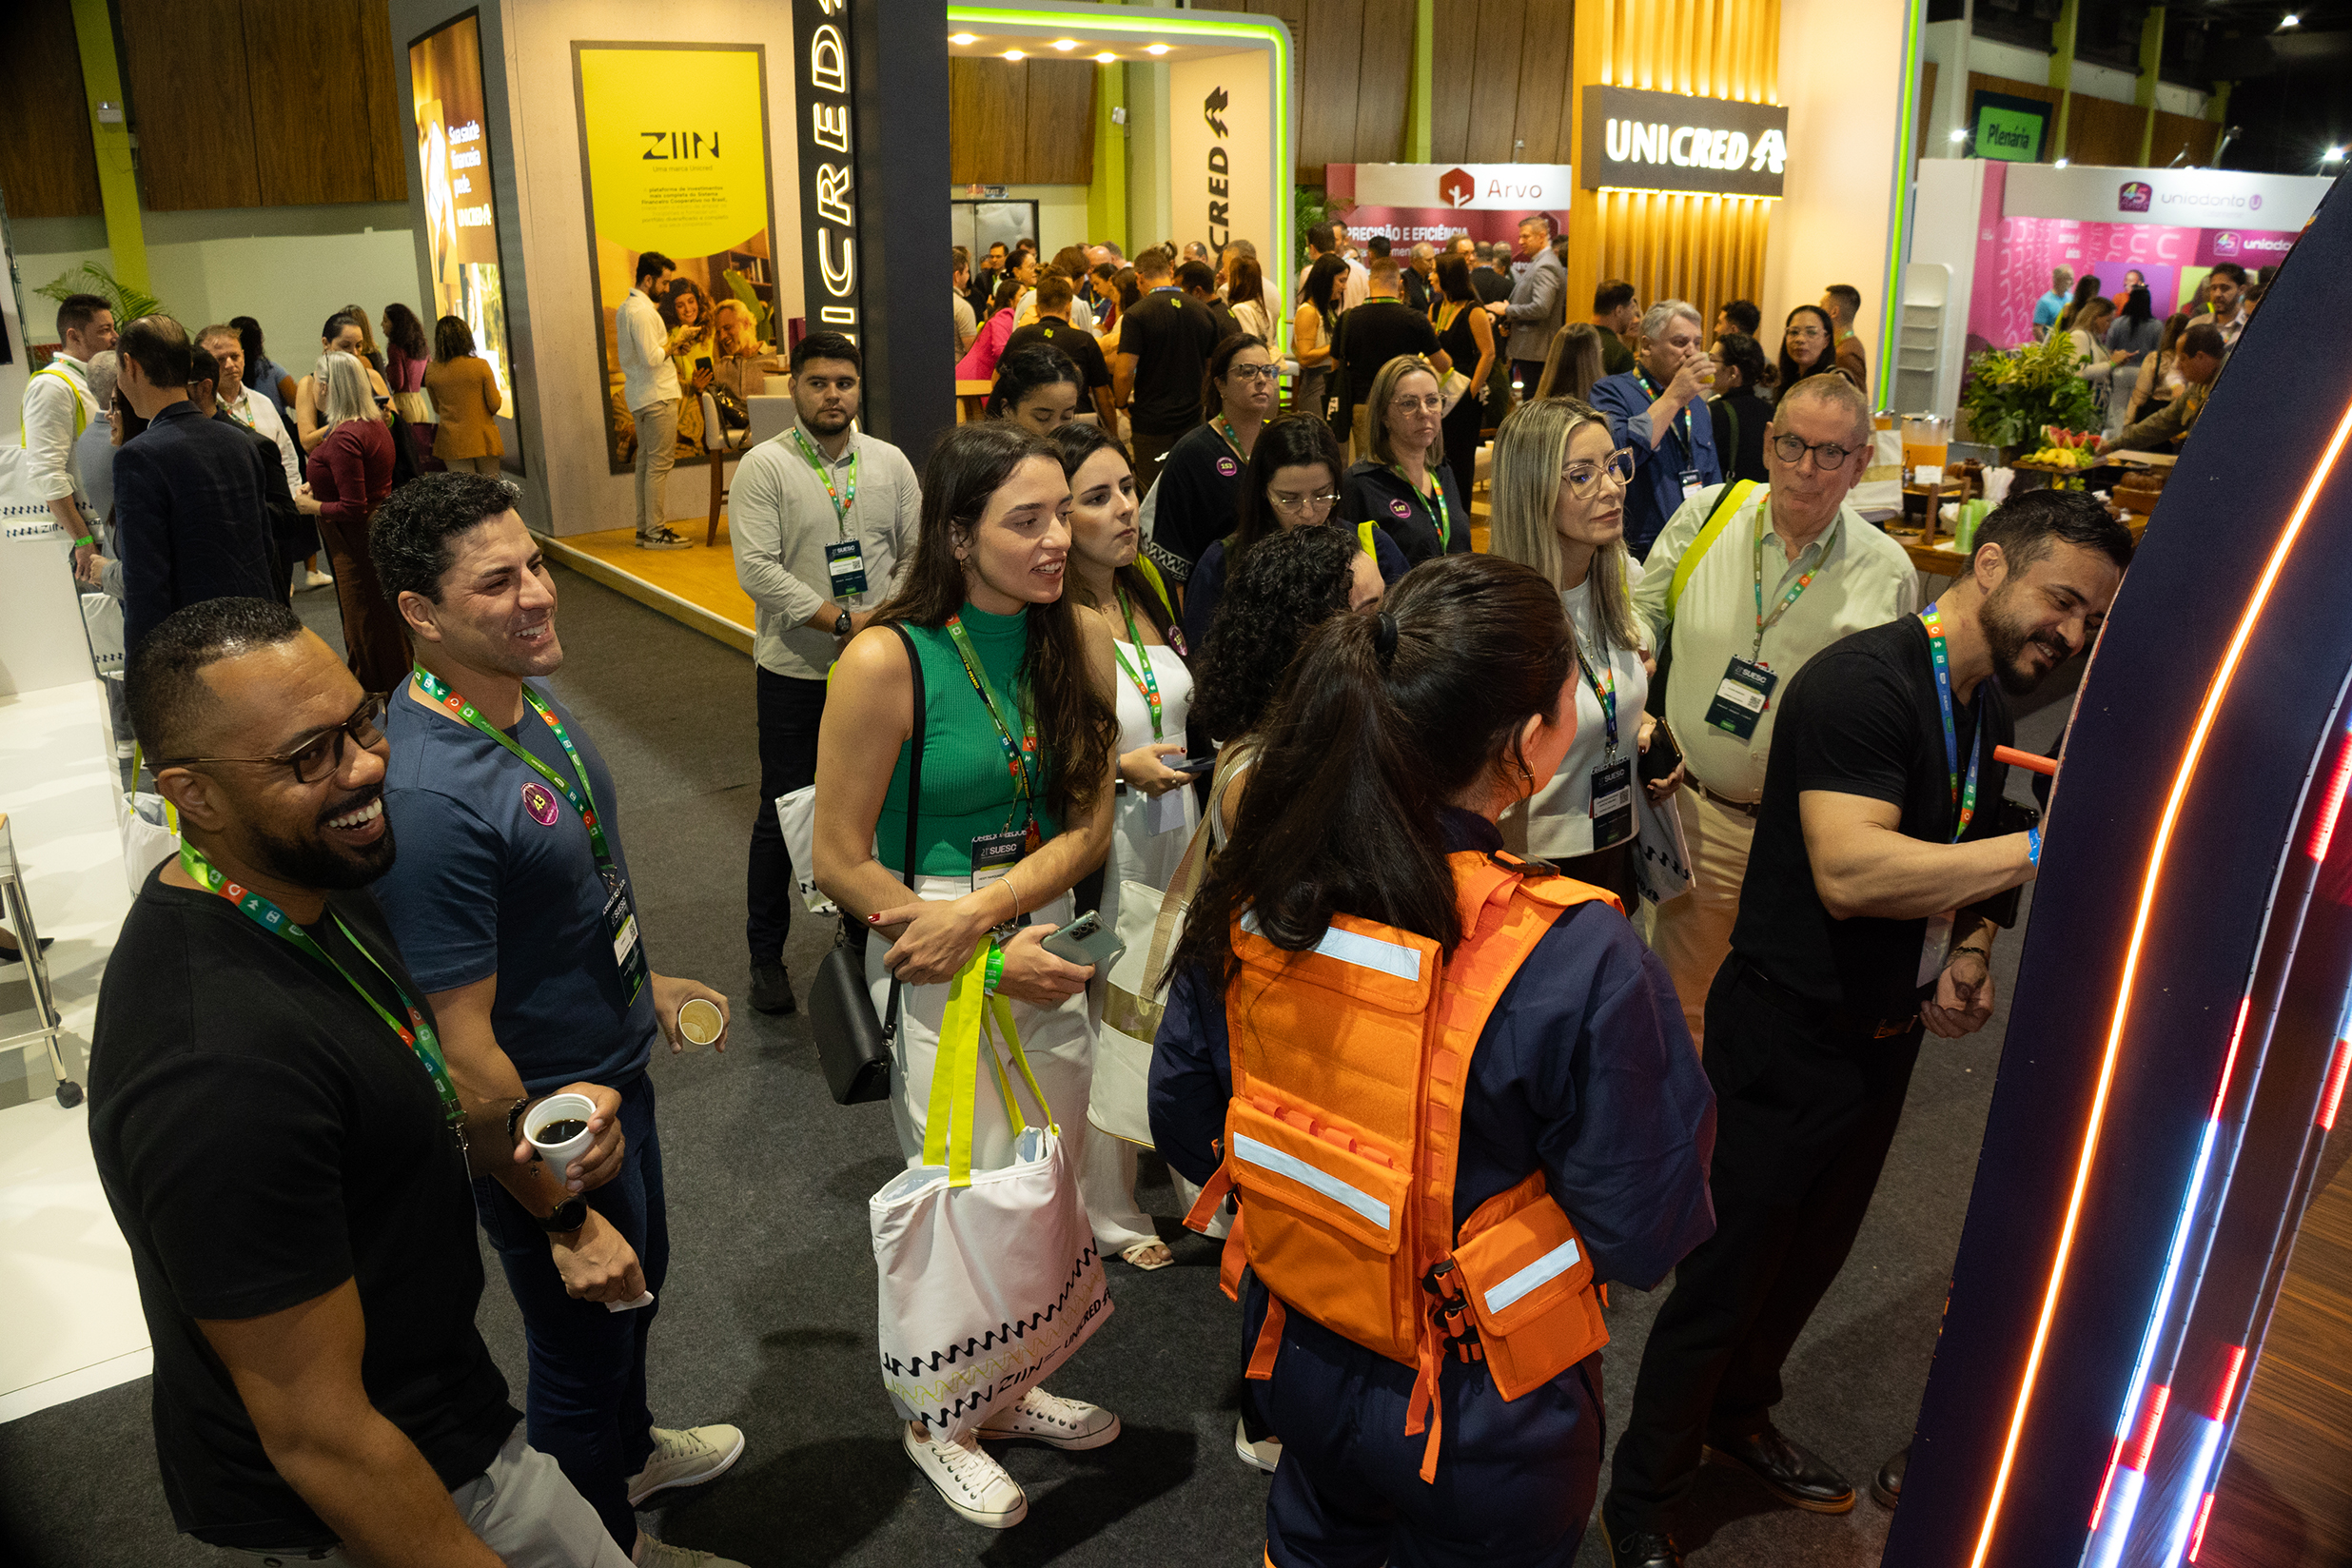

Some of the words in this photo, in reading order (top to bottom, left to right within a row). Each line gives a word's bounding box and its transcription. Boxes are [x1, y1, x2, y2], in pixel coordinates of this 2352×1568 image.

[640, 131, 719, 160] ZIIN
[1605, 118, 1750, 171] UNICRED
[1987, 124, 2029, 148] Plenária
[811, 24, 857, 347] ICRED
[1487, 179, 1543, 199] Arvo
[2123, 184, 2148, 204] 45
[2161, 193, 2245, 207] uniodonto
[1208, 147, 1229, 255] CRED
[1347, 224, 1401, 241] PRECISÃO
[1402, 227, 1411, 241] E
[2244, 239, 2293, 251] uniodo
[1742, 669, 1767, 683] SUESC
[533, 794, 546, 811] 43
[990, 843, 1017, 855] SUESC
[1065, 1299, 1102, 1348] UNICRED
[997, 1357, 1043, 1395] ZIIN
